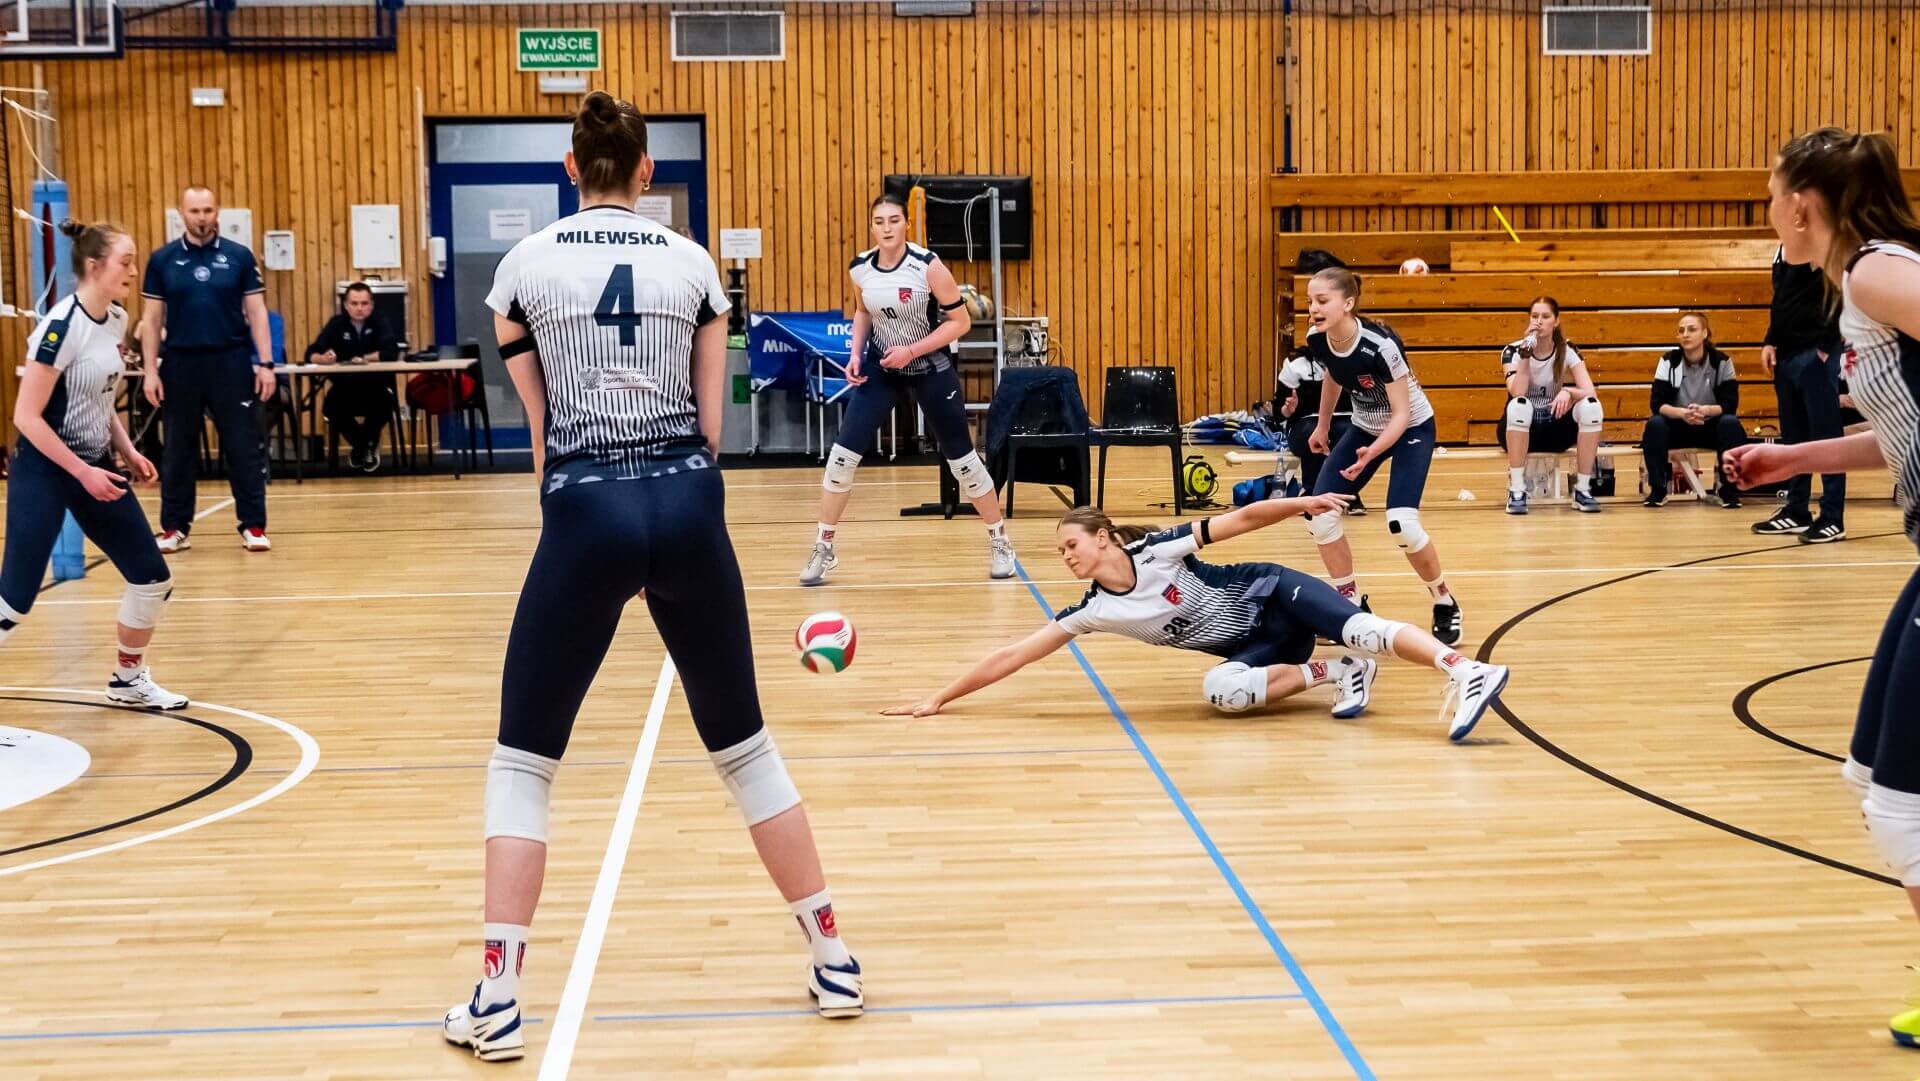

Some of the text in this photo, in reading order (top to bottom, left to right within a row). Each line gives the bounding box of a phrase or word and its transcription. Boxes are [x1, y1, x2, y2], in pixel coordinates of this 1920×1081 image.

[525, 34, 593, 50] WYJŚCIE
[521, 53, 597, 62] EWAKUACYJNE
[556, 231, 669, 247] MILEWSKA
[593, 264, 642, 346] 4
[881, 307, 897, 320] 10
[1163, 616, 1191, 636] 28
